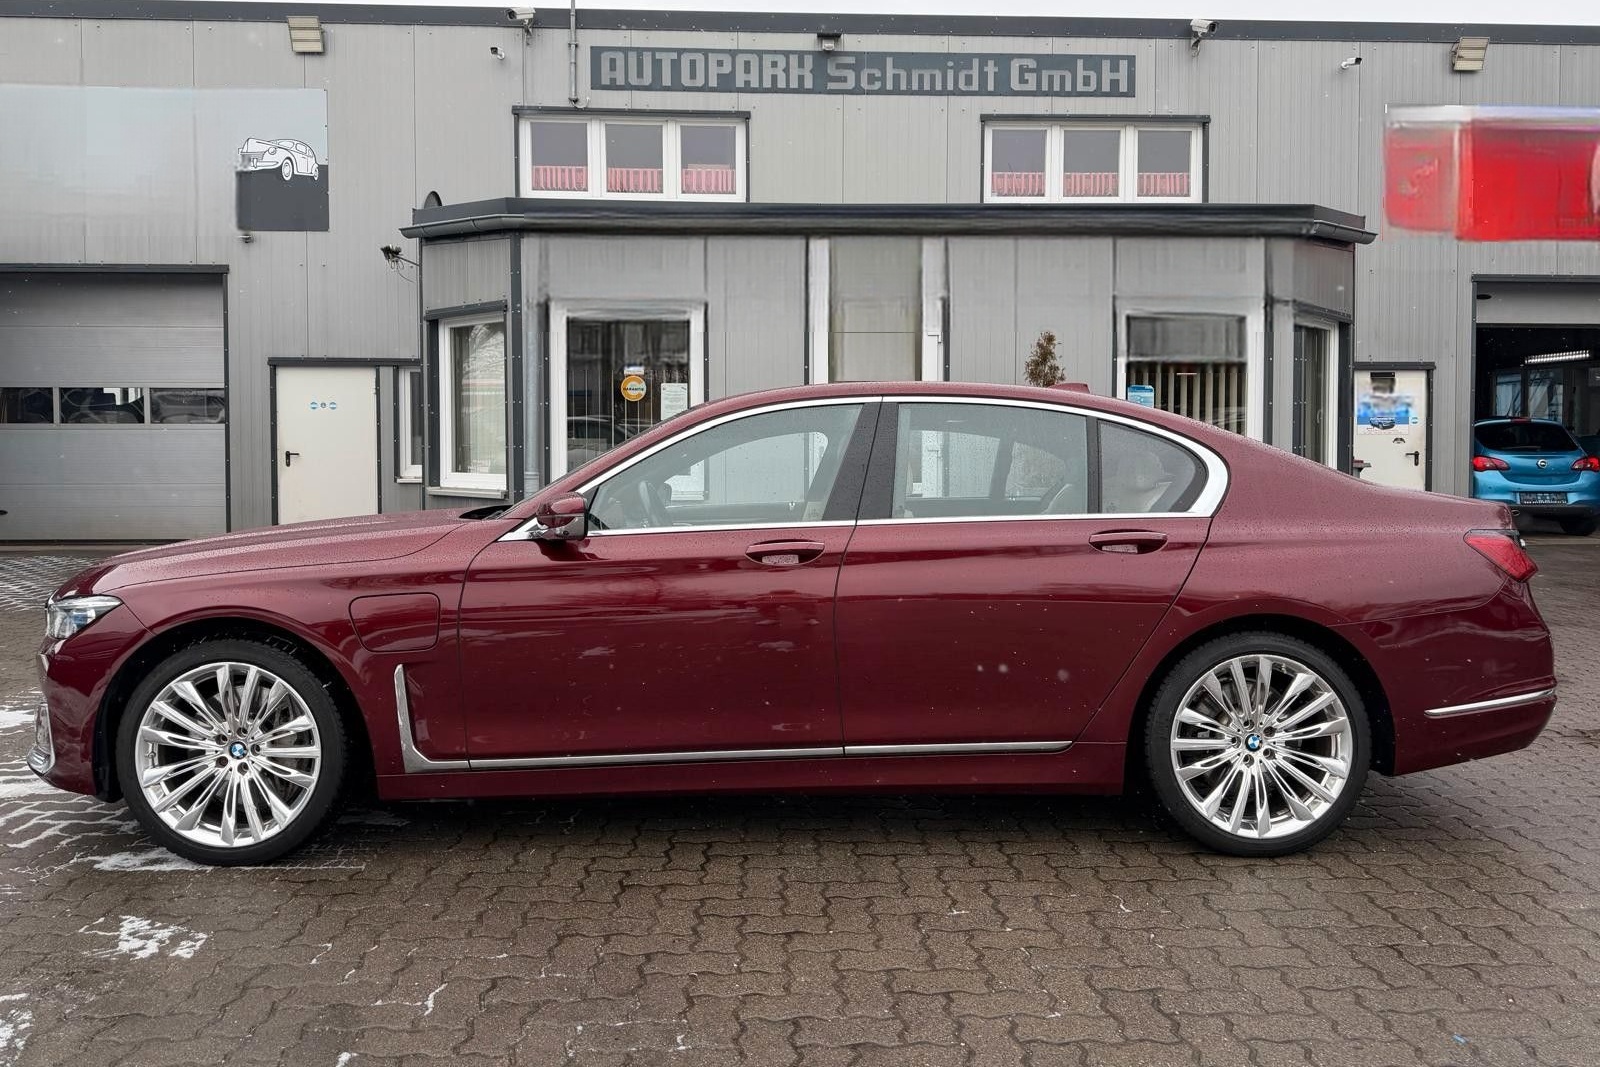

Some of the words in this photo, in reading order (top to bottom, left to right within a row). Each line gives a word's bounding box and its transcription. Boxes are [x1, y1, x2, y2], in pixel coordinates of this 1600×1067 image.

[600, 51, 813, 89] AUTOPARK
[826, 56, 998, 91] Schmidt
[1010, 57, 1128, 92] GmbH
